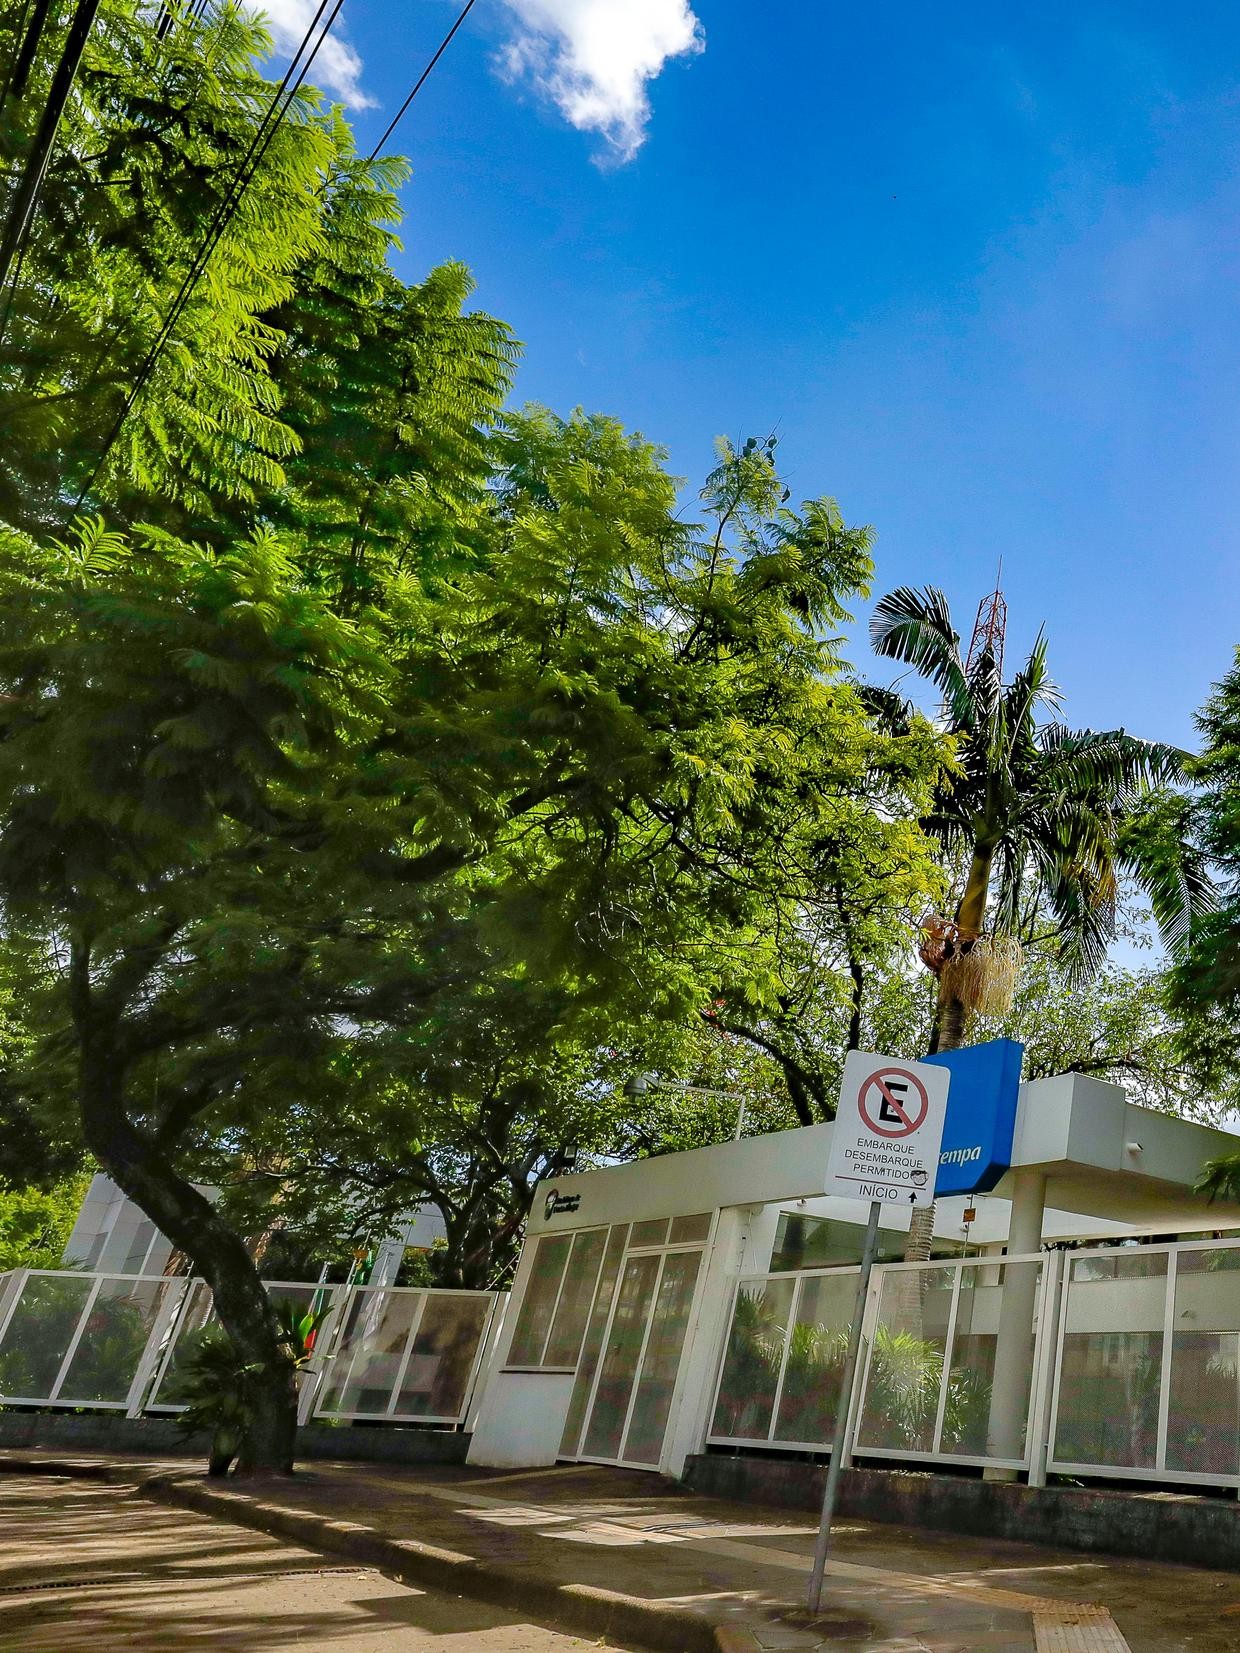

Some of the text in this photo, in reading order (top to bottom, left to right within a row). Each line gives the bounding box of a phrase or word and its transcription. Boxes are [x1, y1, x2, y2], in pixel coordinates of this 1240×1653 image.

[879, 1081, 908, 1124] E
[857, 1138, 915, 1155] EMBARQUE
[844, 1149, 923, 1168] DESEMBARQUE
[939, 1146, 982, 1167] empa
[853, 1163, 910, 1180] PERMITIDO
[859, 1184, 898, 1200] INÍCIO
